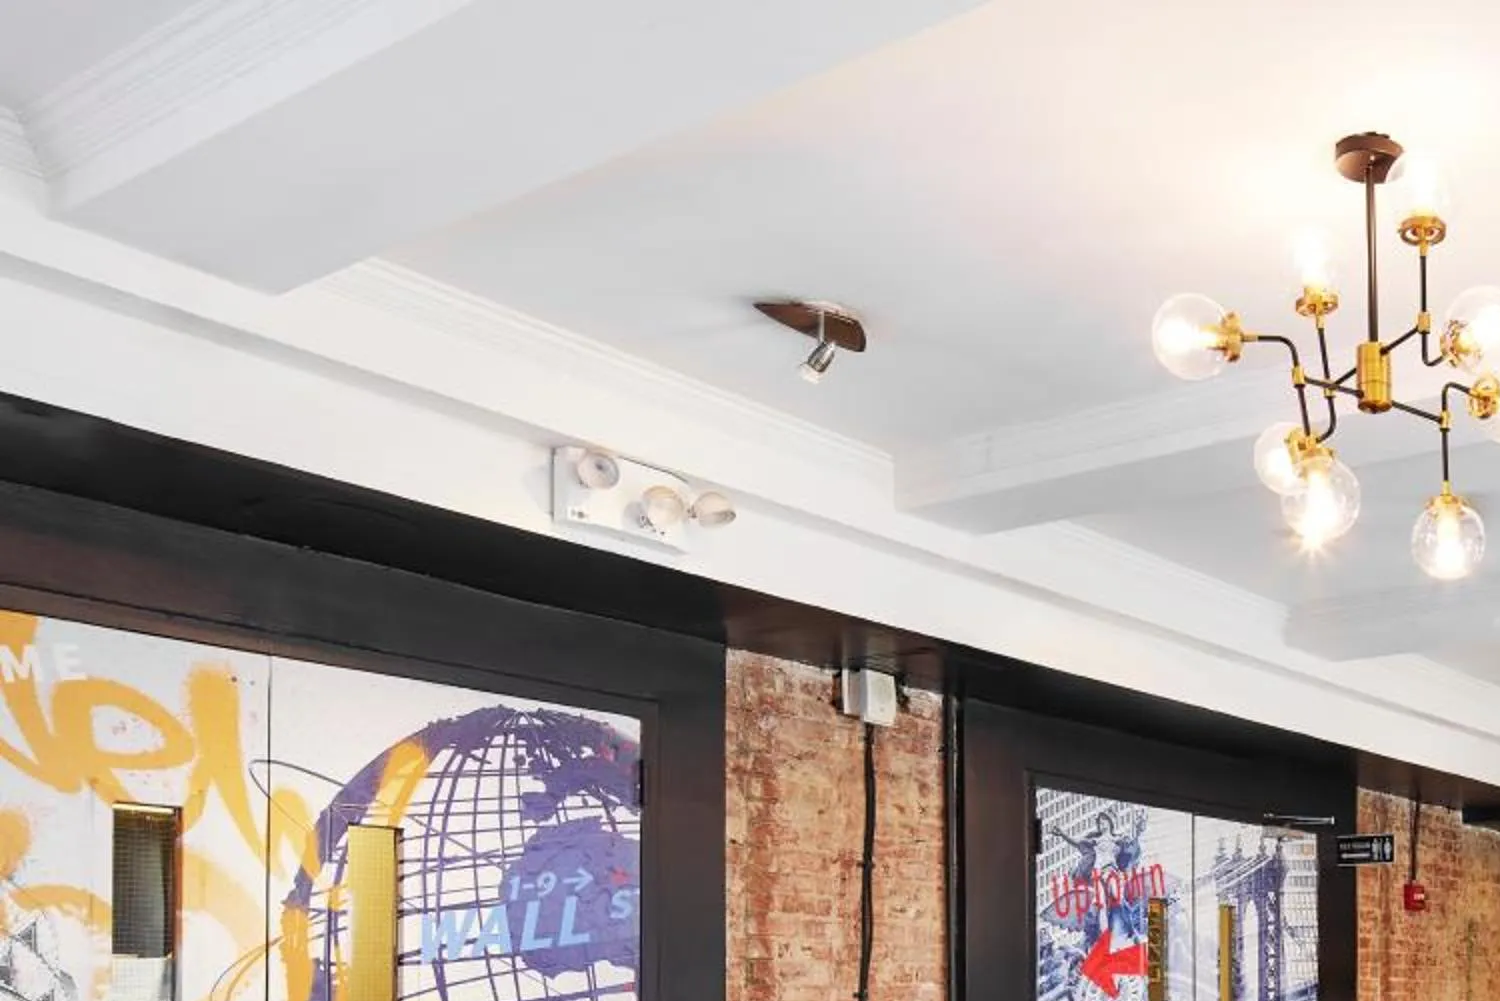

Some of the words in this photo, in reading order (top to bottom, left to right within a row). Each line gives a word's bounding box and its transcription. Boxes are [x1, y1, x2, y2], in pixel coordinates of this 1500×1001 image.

[420, 896, 591, 963] WALL
[609, 887, 640, 919] S
[1050, 863, 1165, 925] Uptown
